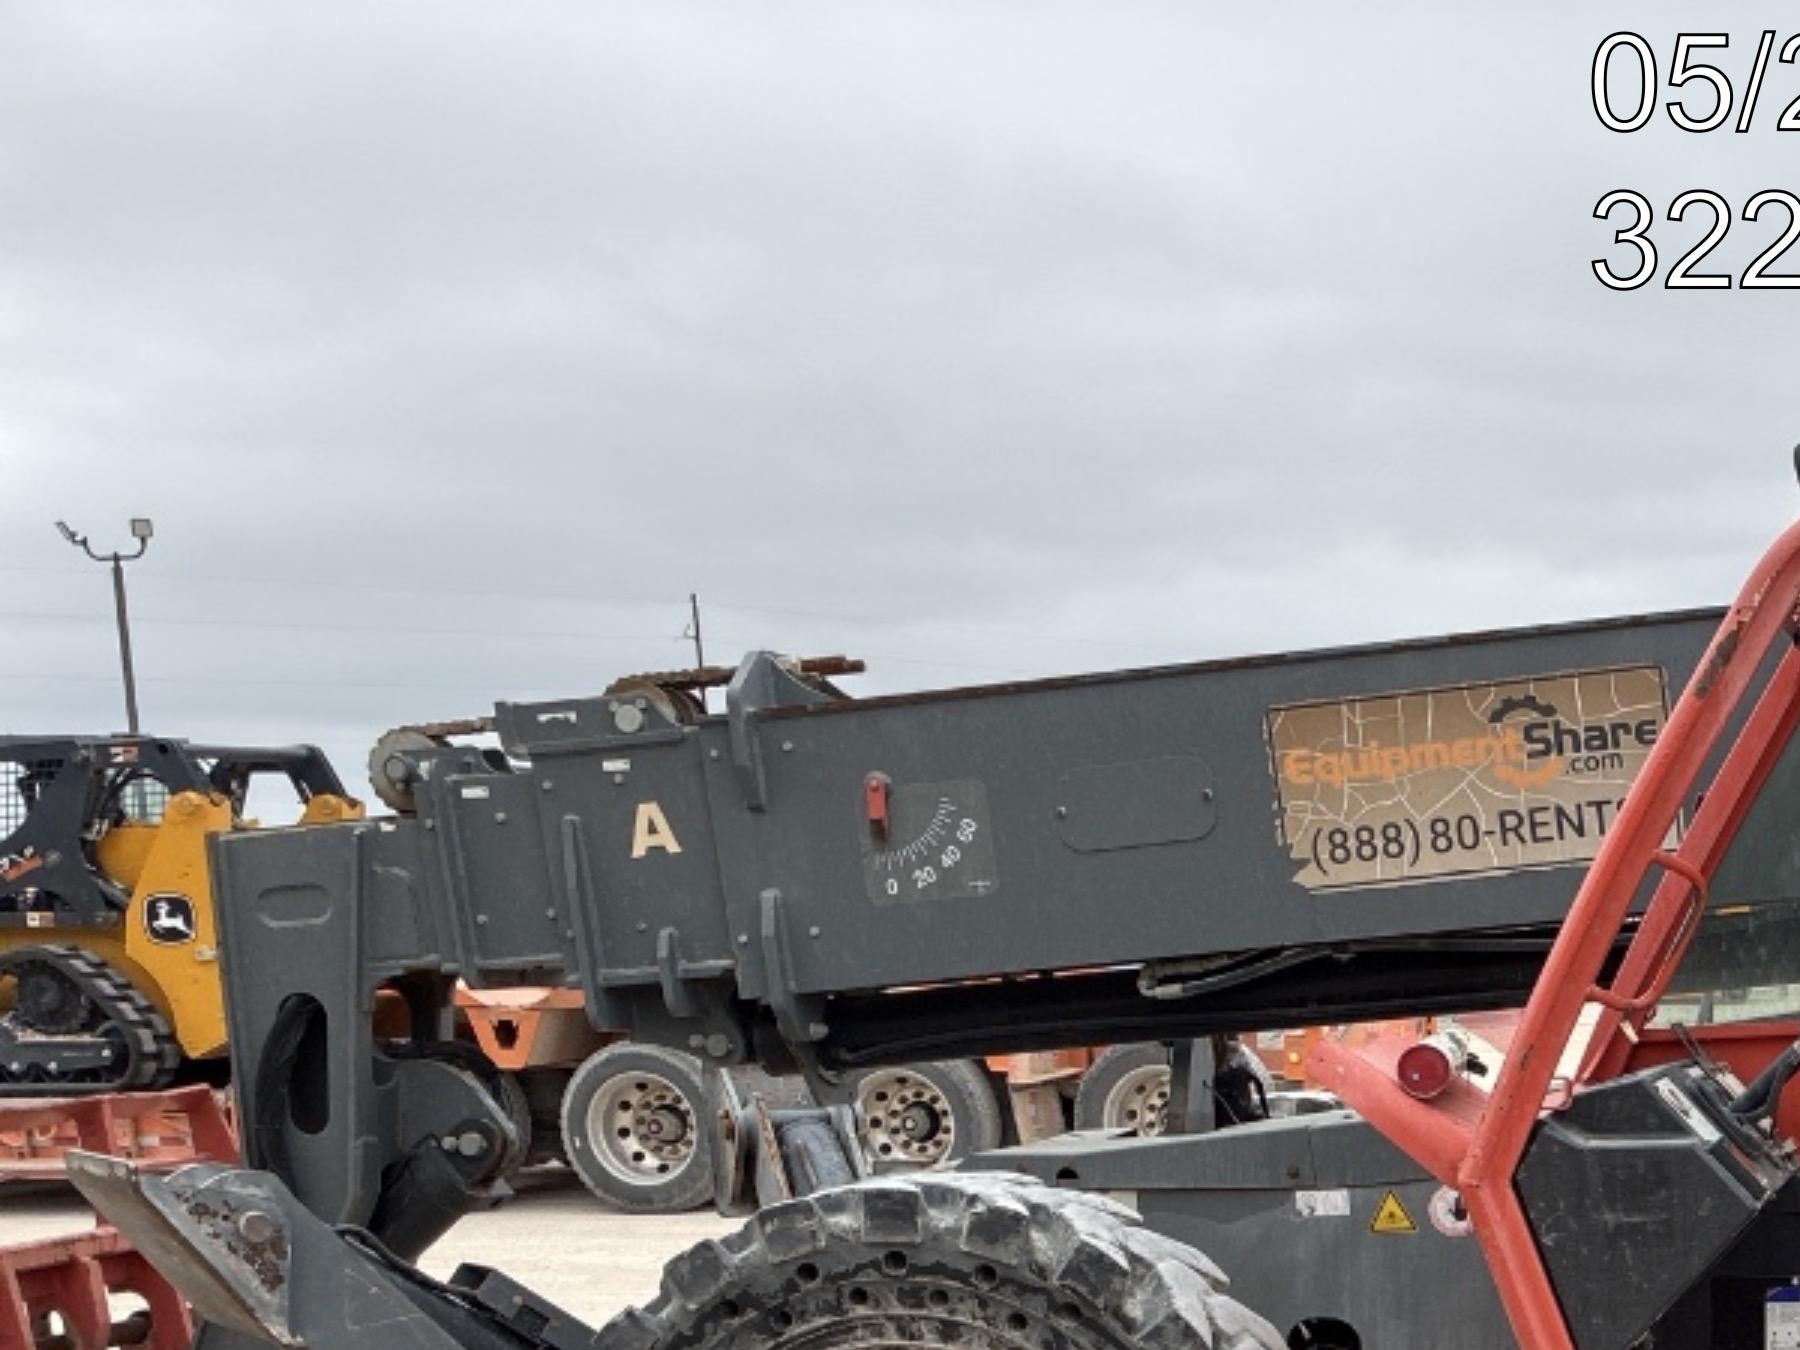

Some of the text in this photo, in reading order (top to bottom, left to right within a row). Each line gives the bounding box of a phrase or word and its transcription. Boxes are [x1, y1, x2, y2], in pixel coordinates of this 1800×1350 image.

[631, 801, 683, 860] A
[1311, 816, 1422, 877] (888)
[886, 878, 899, 896] 0
[911, 865, 937, 889] 20
